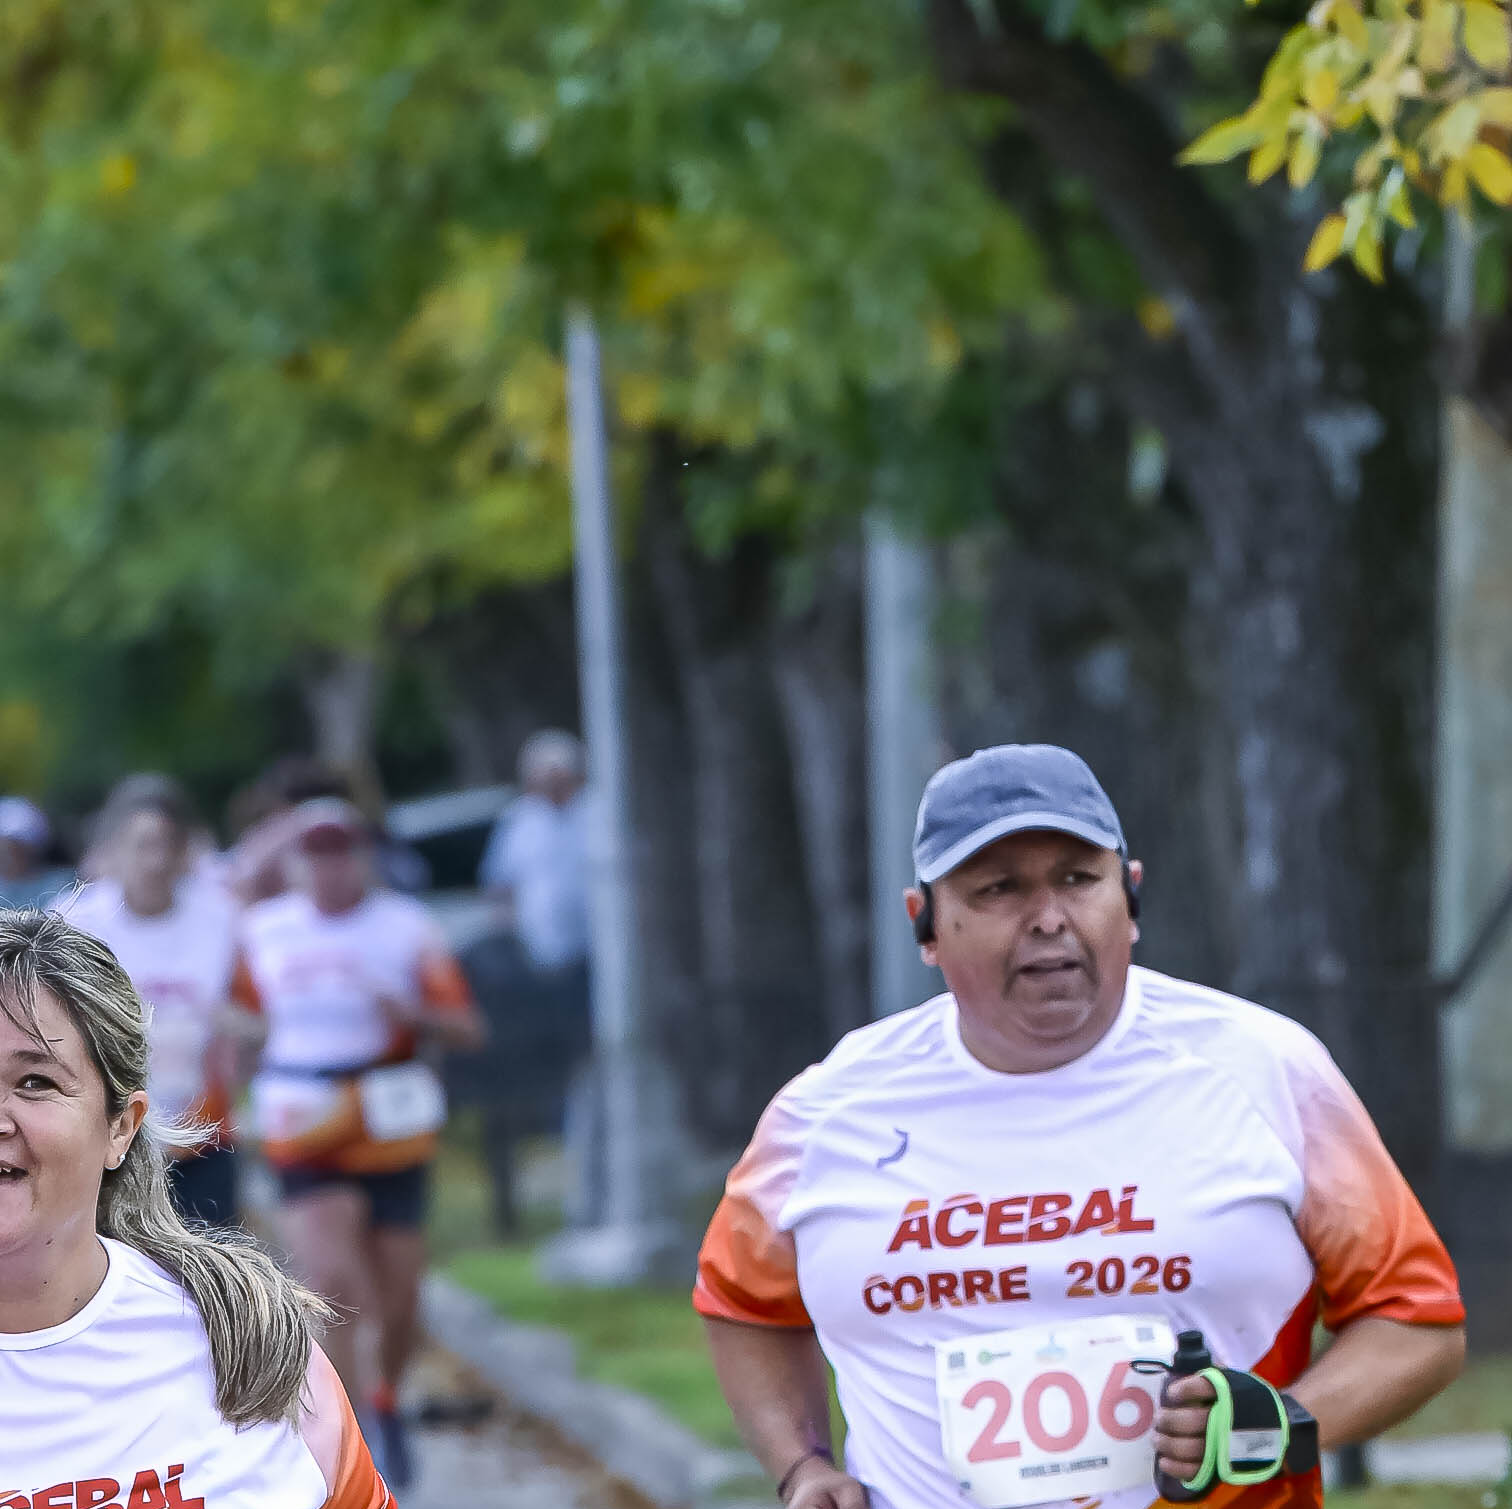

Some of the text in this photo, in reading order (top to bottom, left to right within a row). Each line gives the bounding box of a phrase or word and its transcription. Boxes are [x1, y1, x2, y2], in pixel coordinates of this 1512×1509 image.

[887, 1184, 1155, 1254] ACEBAL
[863, 1255, 1193, 1315] CORRE 2026
[960, 1361, 1155, 1463] 206
